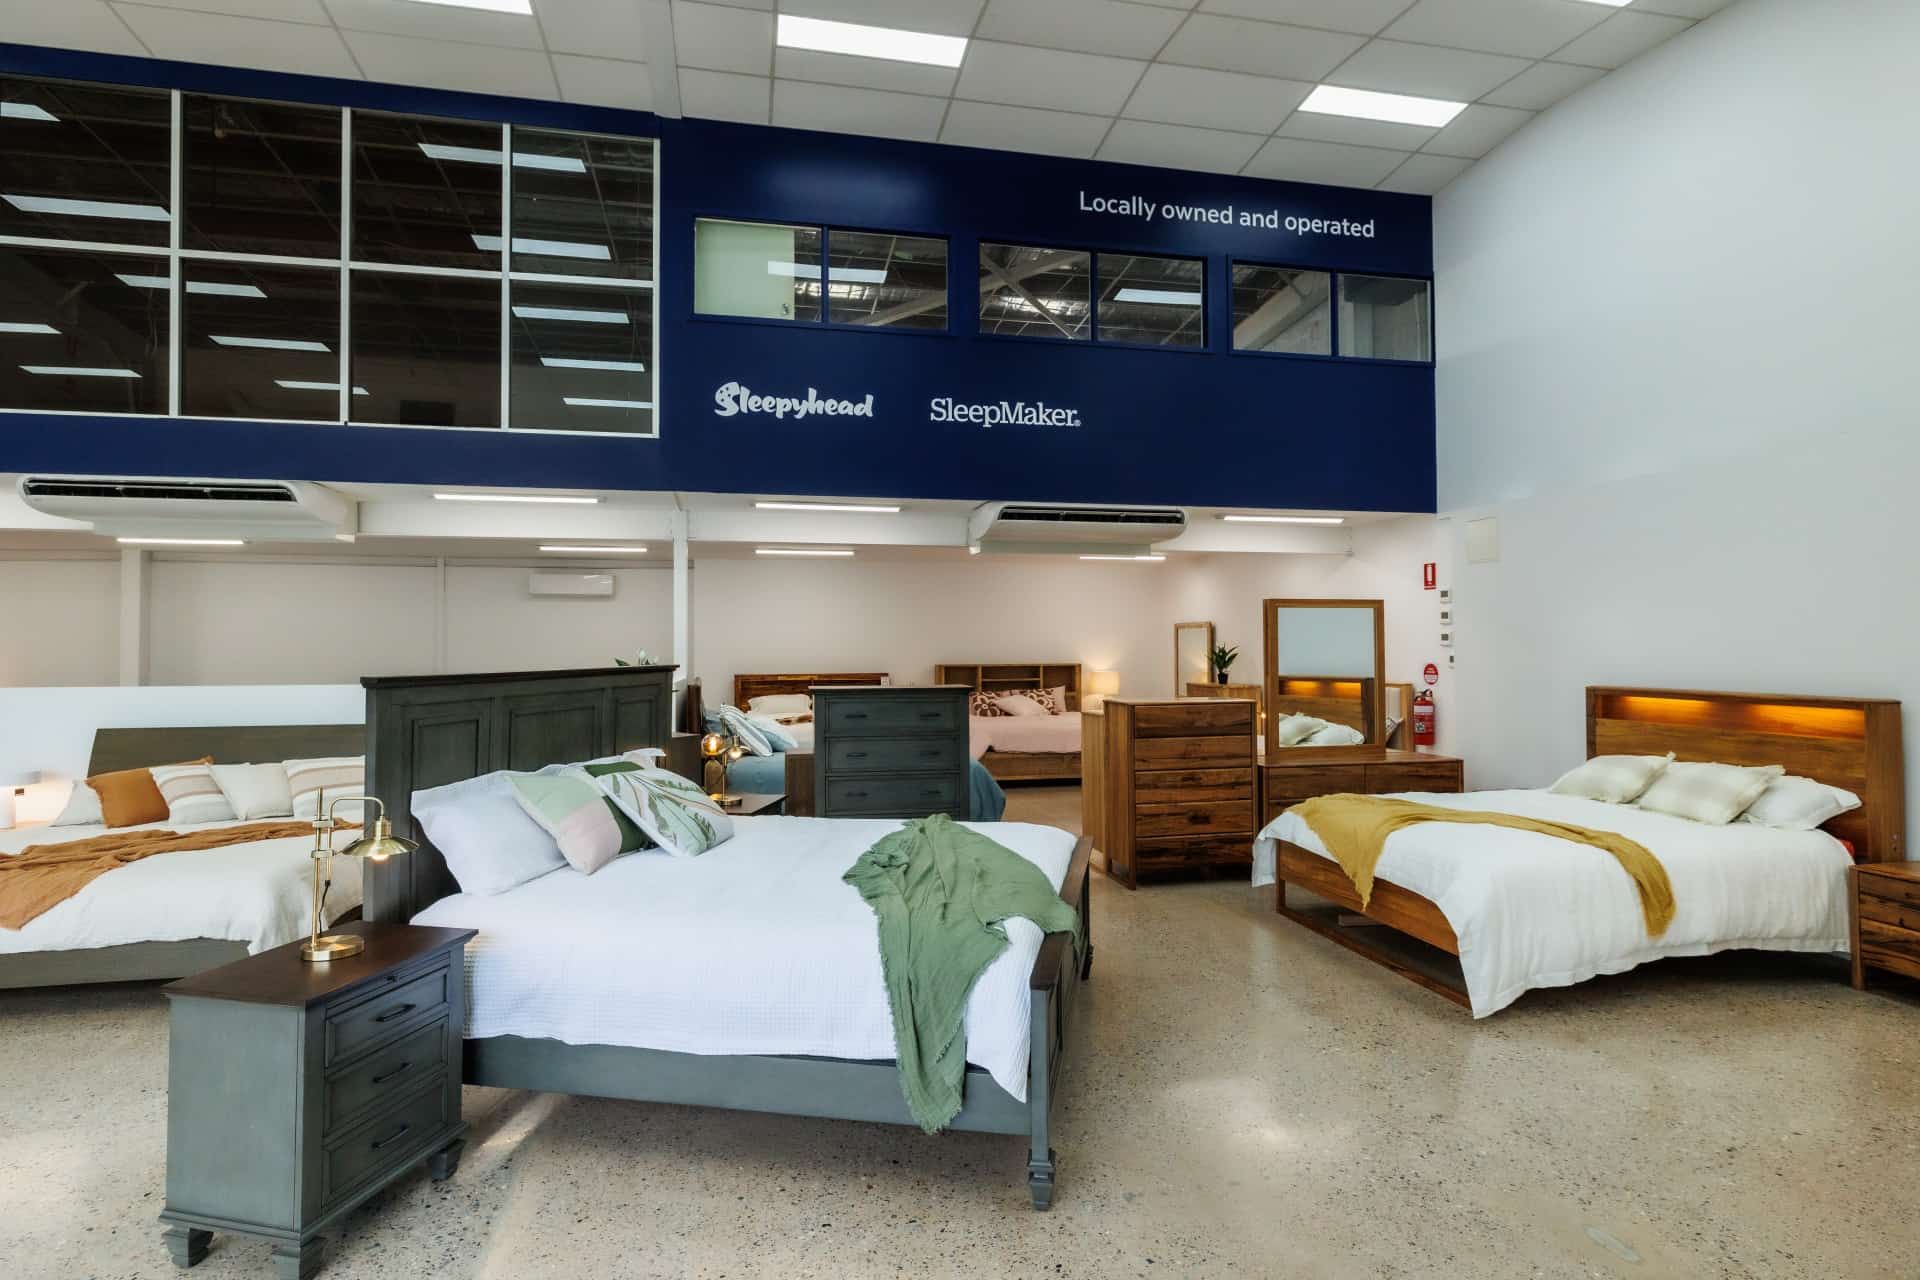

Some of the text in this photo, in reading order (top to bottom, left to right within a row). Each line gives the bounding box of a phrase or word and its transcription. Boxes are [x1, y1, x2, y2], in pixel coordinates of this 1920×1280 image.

[1080, 191, 1375, 238] Locally owned and operated
[714, 381, 874, 420] Sleepyhead
